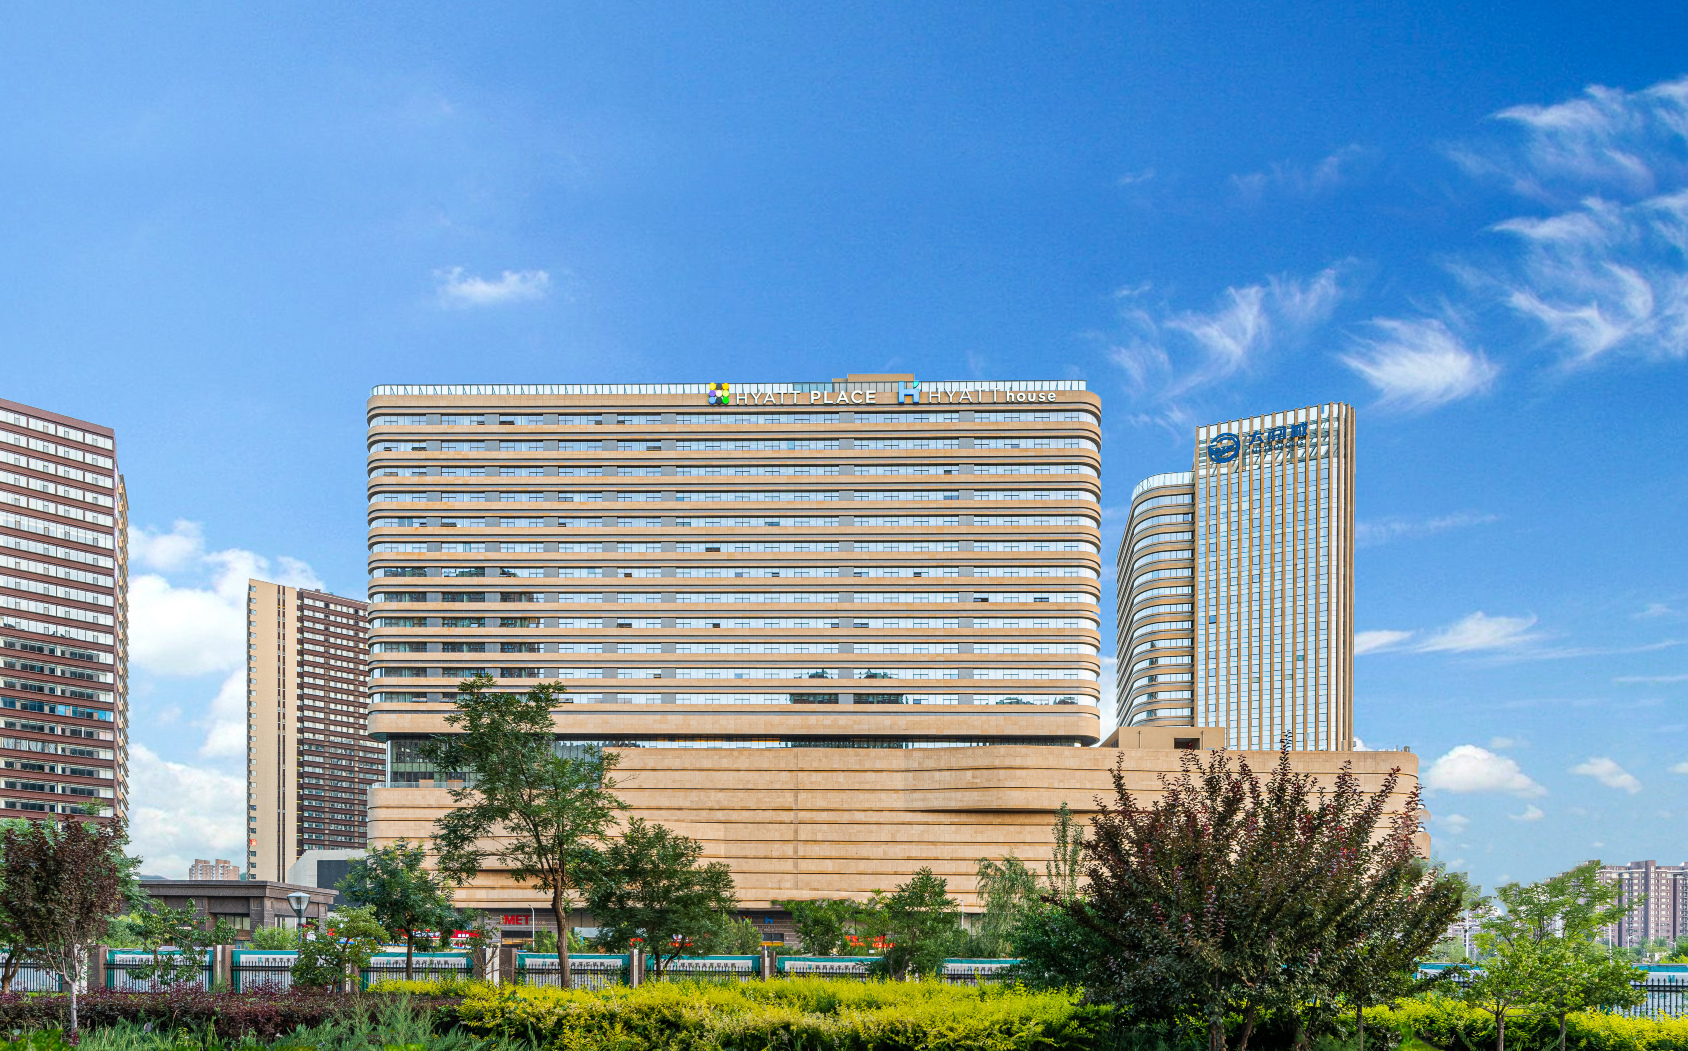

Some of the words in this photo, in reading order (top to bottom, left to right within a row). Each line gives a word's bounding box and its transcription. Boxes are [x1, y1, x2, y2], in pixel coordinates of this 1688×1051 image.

[736, 390, 801, 405] HYATT
[810, 390, 877, 405] PLACE
[929, 388, 1001, 403] HYATT
[1006, 388, 1057, 403] house
[504, 914, 531, 925] MET
